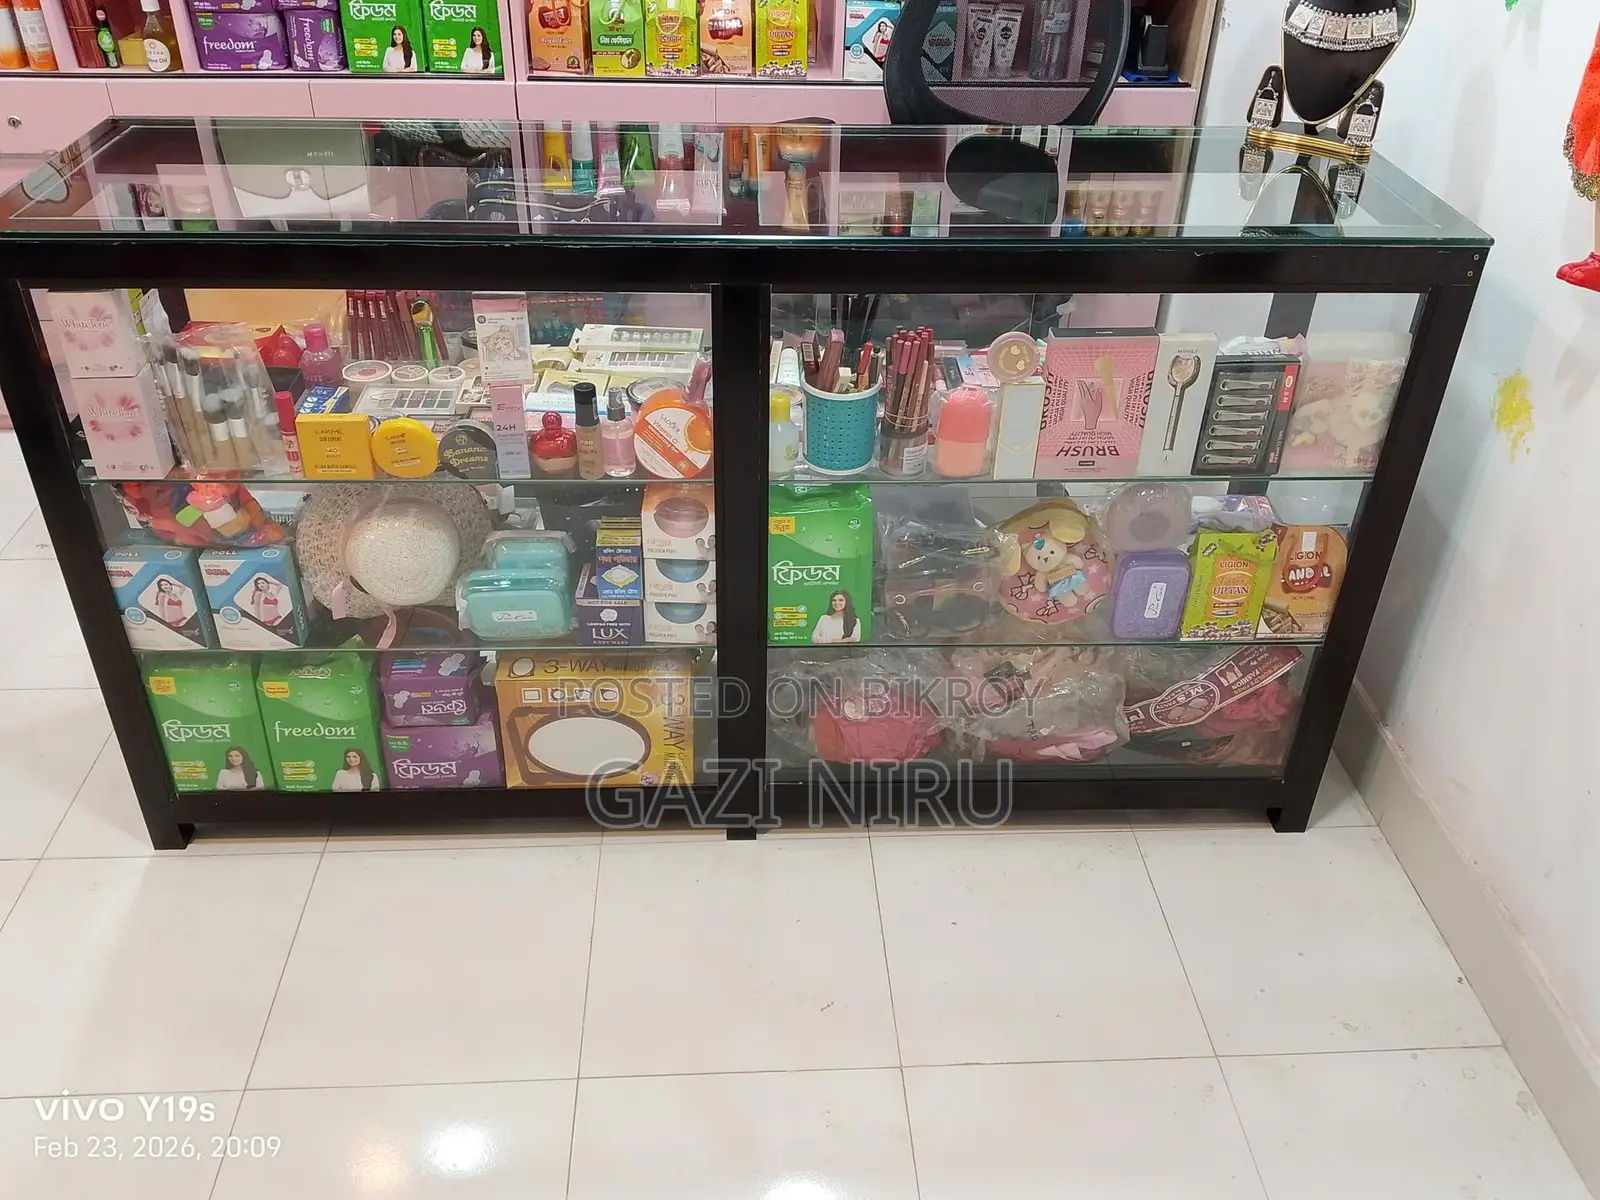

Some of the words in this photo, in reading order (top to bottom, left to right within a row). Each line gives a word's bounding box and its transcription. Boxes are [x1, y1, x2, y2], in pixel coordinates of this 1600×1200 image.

[203, 36, 257, 55] freedom
[297, 17, 316, 62] freedom
[496, 424, 516, 432] 24H
[1056, 445, 1120, 457] BRUSH
[449, 456, 489, 467] Dreams
[771, 560, 842, 585] ফ্রিডম
[592, 628, 629, 640] LUX
[544, 659, 608, 674] 3-WAY
[161, 719, 231, 742] ফ্রিডম
[273, 720, 356, 742] freedom
[392, 758, 458, 778] ফ্রিডম
